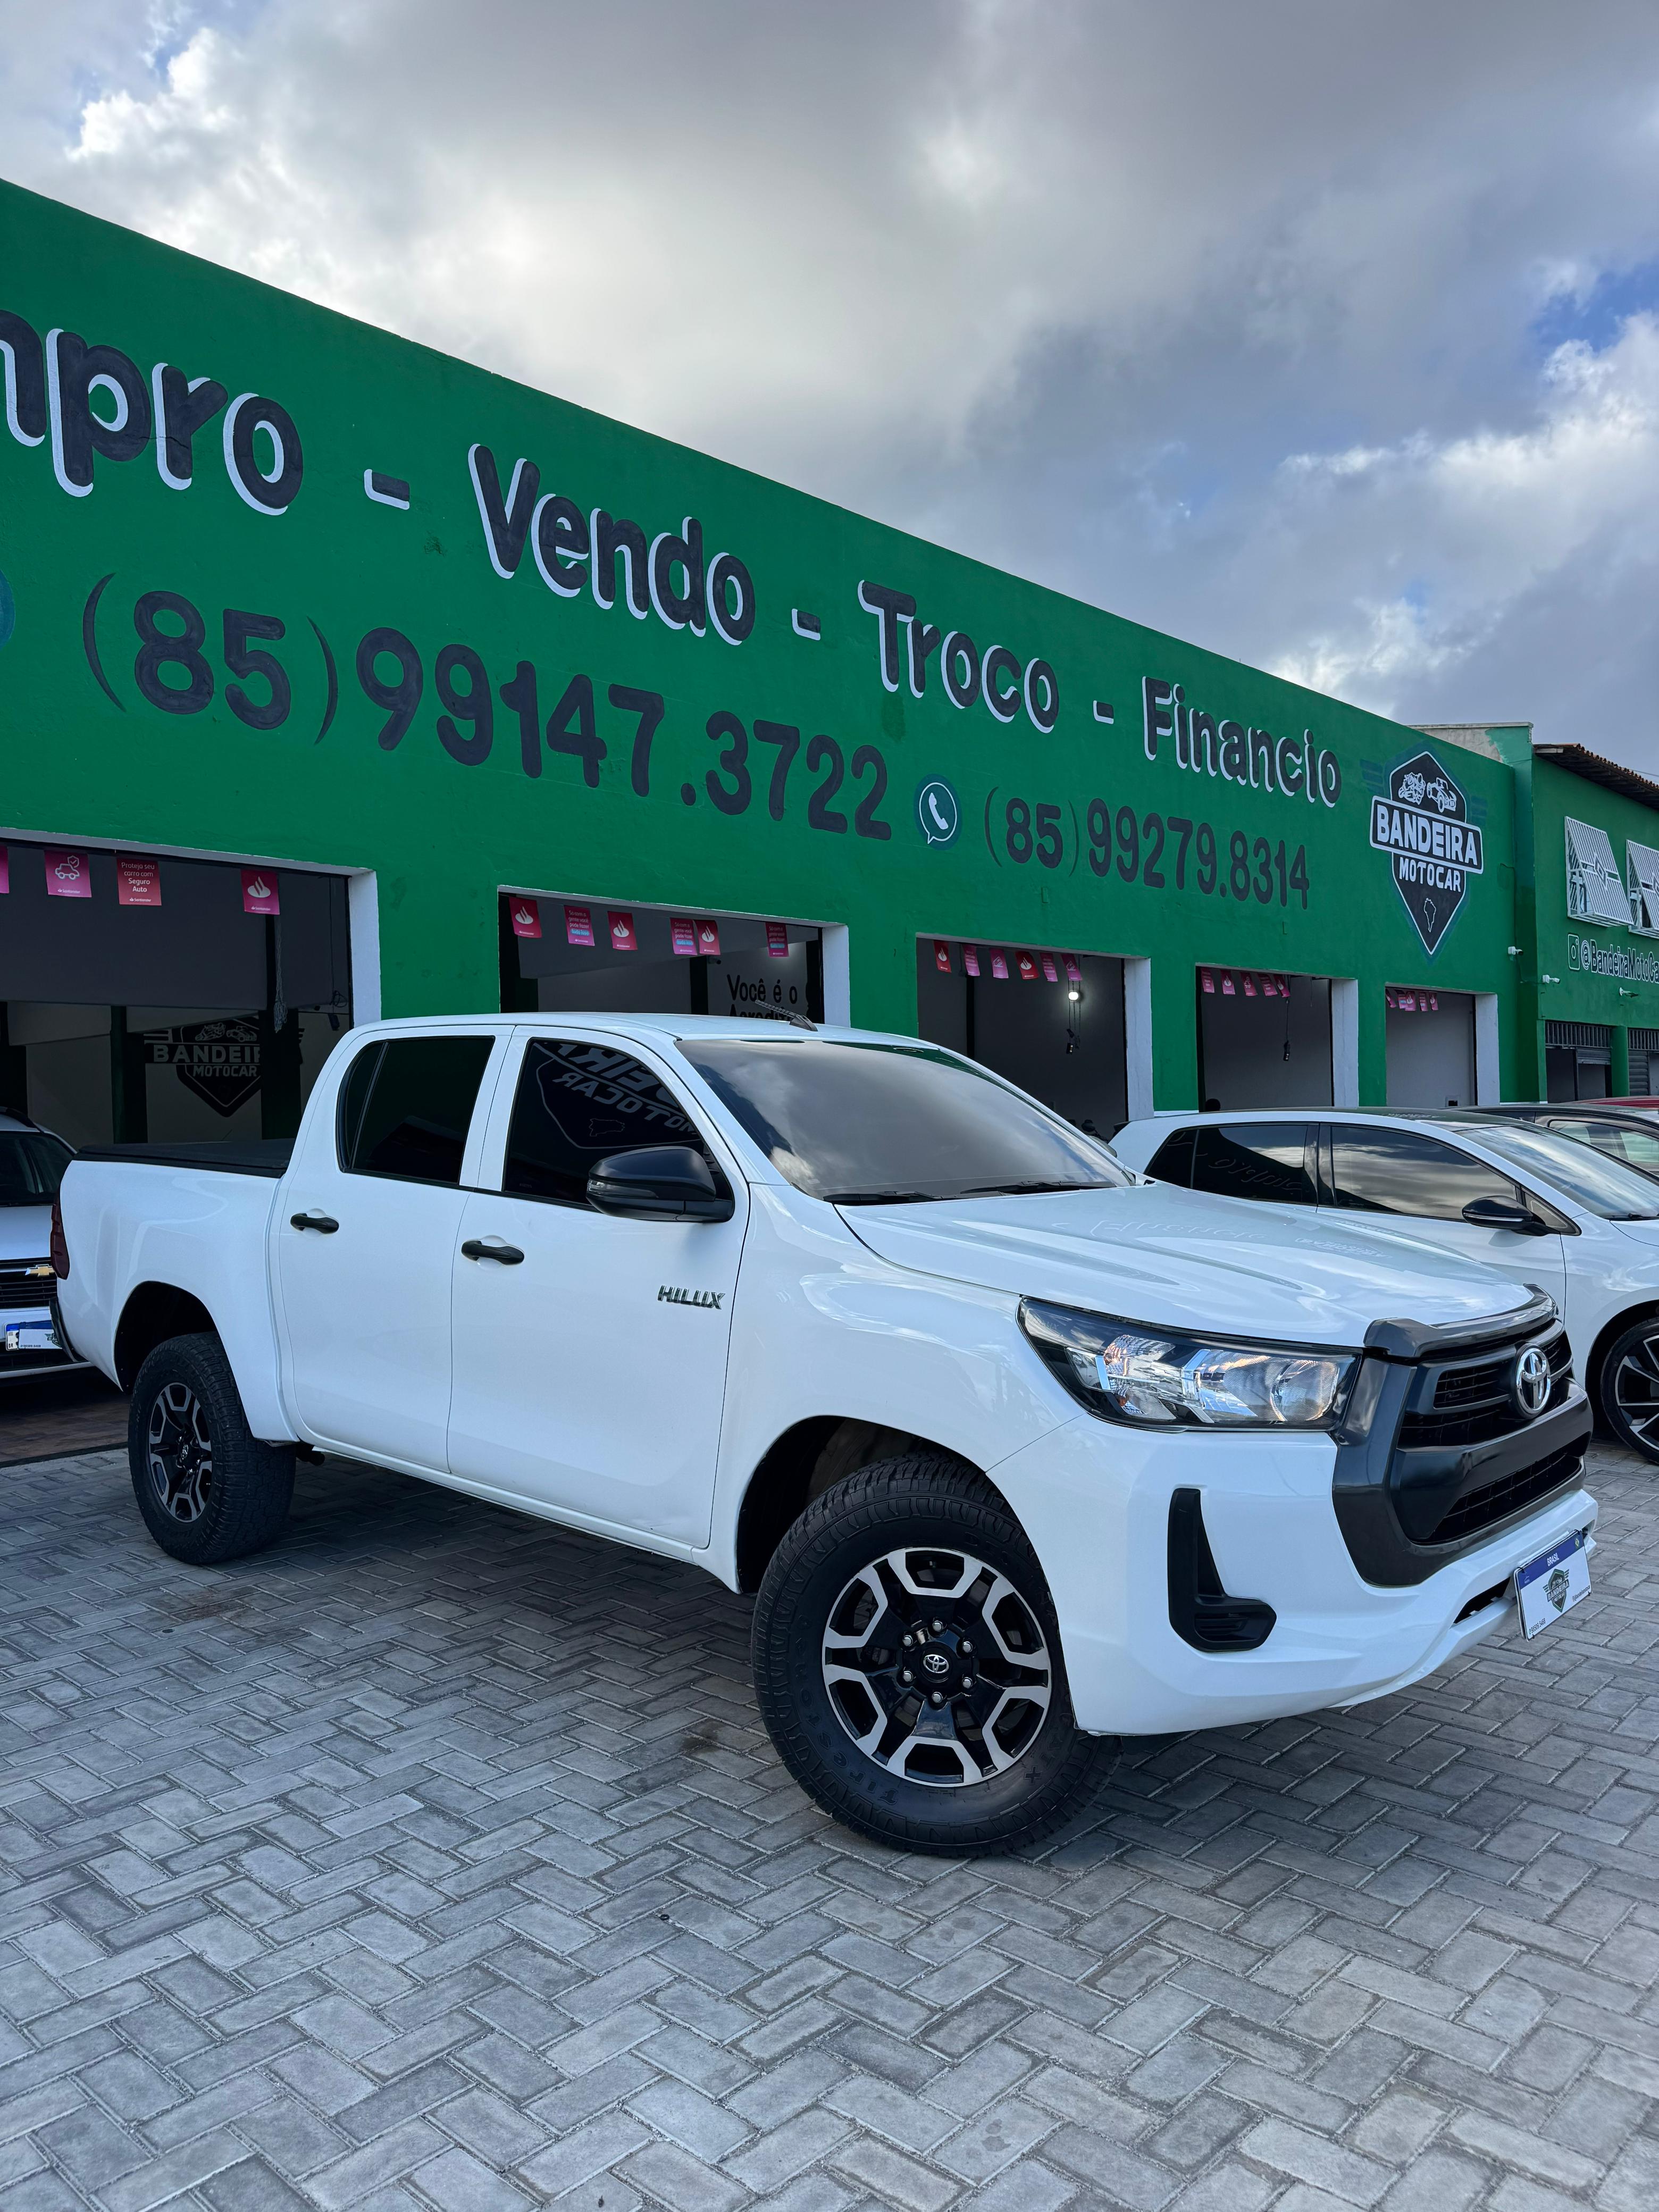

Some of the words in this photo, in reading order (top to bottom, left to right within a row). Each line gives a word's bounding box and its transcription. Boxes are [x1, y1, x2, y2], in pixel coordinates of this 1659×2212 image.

[468, 443, 755, 645] Vendo
[858, 580, 1059, 734] Troco
[1142, 676, 1342, 808] Financio
[1377, 805, 1478, 865] BANDEIRA
[1399, 857, 1461, 892] MOTOCAR
[726, 974, 766, 1002] Você
[773, 979, 782, 1003] é
[789, 986, 798, 1004] o
[193, 1065, 257, 1077] MOTOCAR
[657, 1285, 726, 1310] HILUX
[1546, 1552, 1560, 1567] BRASIL
